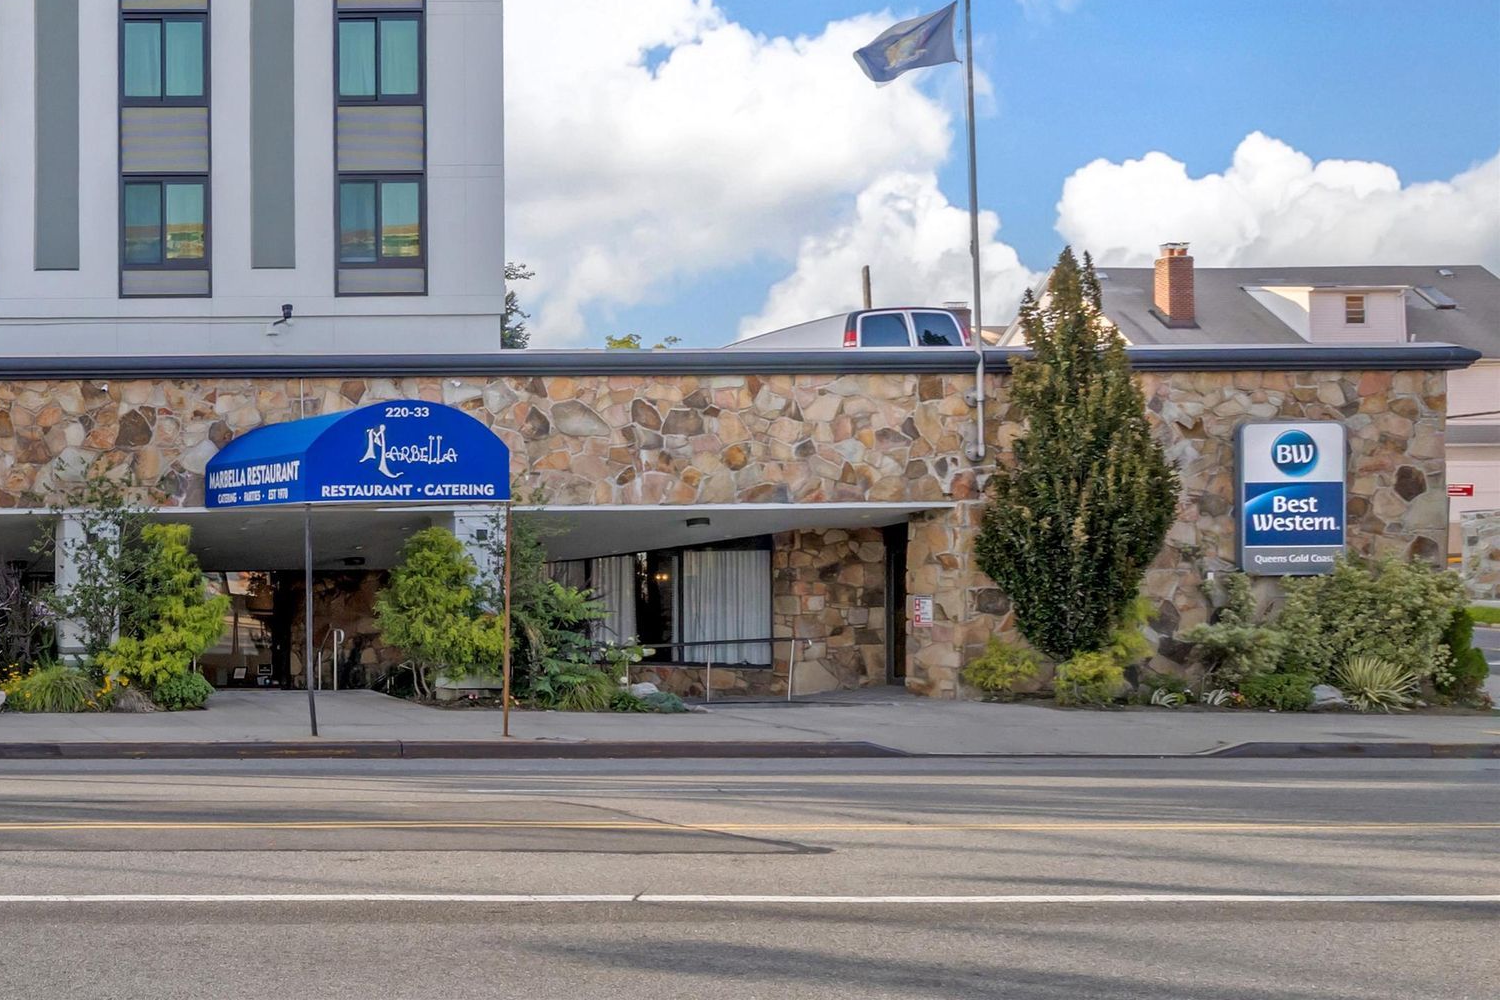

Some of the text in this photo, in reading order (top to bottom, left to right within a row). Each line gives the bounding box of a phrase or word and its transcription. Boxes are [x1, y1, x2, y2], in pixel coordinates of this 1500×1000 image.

[385, 407, 430, 418] 220-33
[1276, 444, 1314, 464] BW
[209, 460, 300, 489] MARBELLA RESTAURANT
[321, 484, 495, 497] RESTAURANT CATERING
[1273, 496, 1318, 513] Best
[1252, 514, 1336, 531] Western
[1254, 554, 1288, 565] Queens
[1288, 554, 1309, 563] Gold
